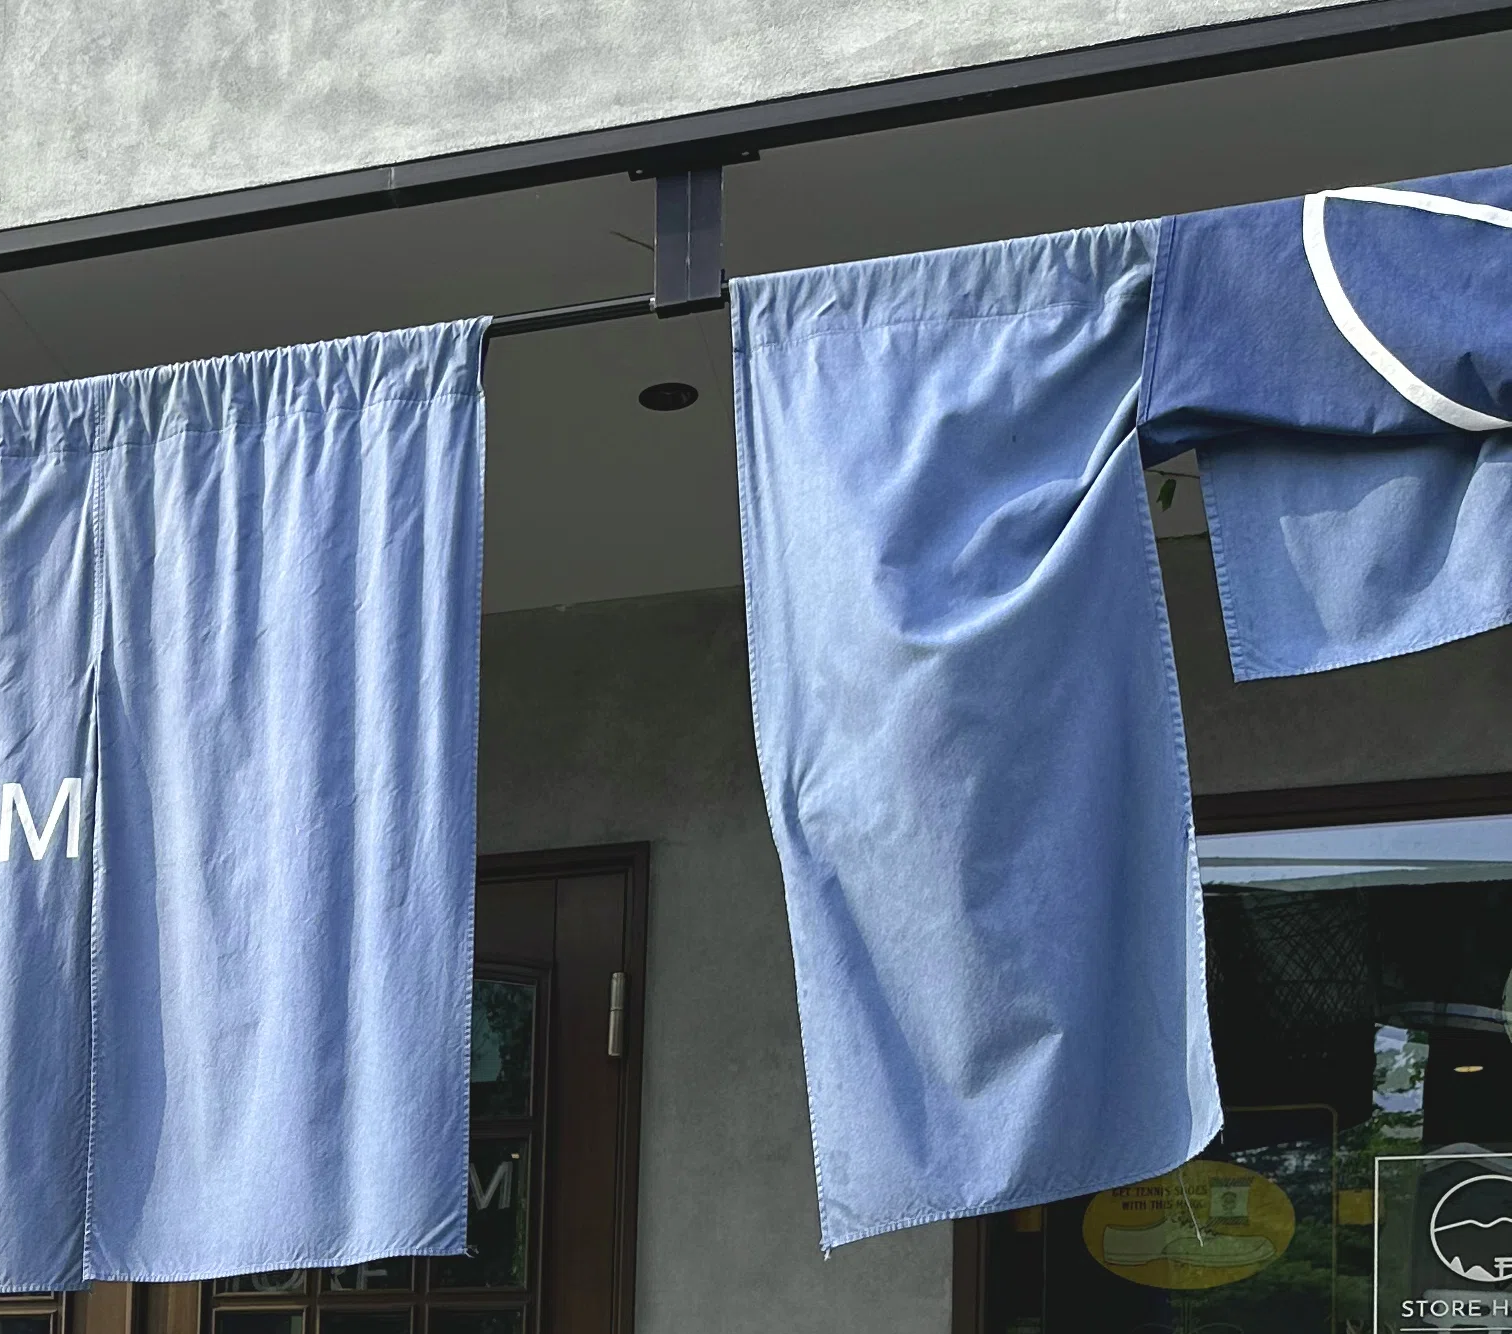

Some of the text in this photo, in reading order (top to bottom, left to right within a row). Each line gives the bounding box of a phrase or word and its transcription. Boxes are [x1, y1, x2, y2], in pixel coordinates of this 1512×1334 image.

[1136, 1186, 1170, 1196] TENNIS
[1122, 1200, 1147, 1210] WITH
[1151, 1199, 1173, 1210] THIS
[1401, 1299, 1482, 1318] STORE
